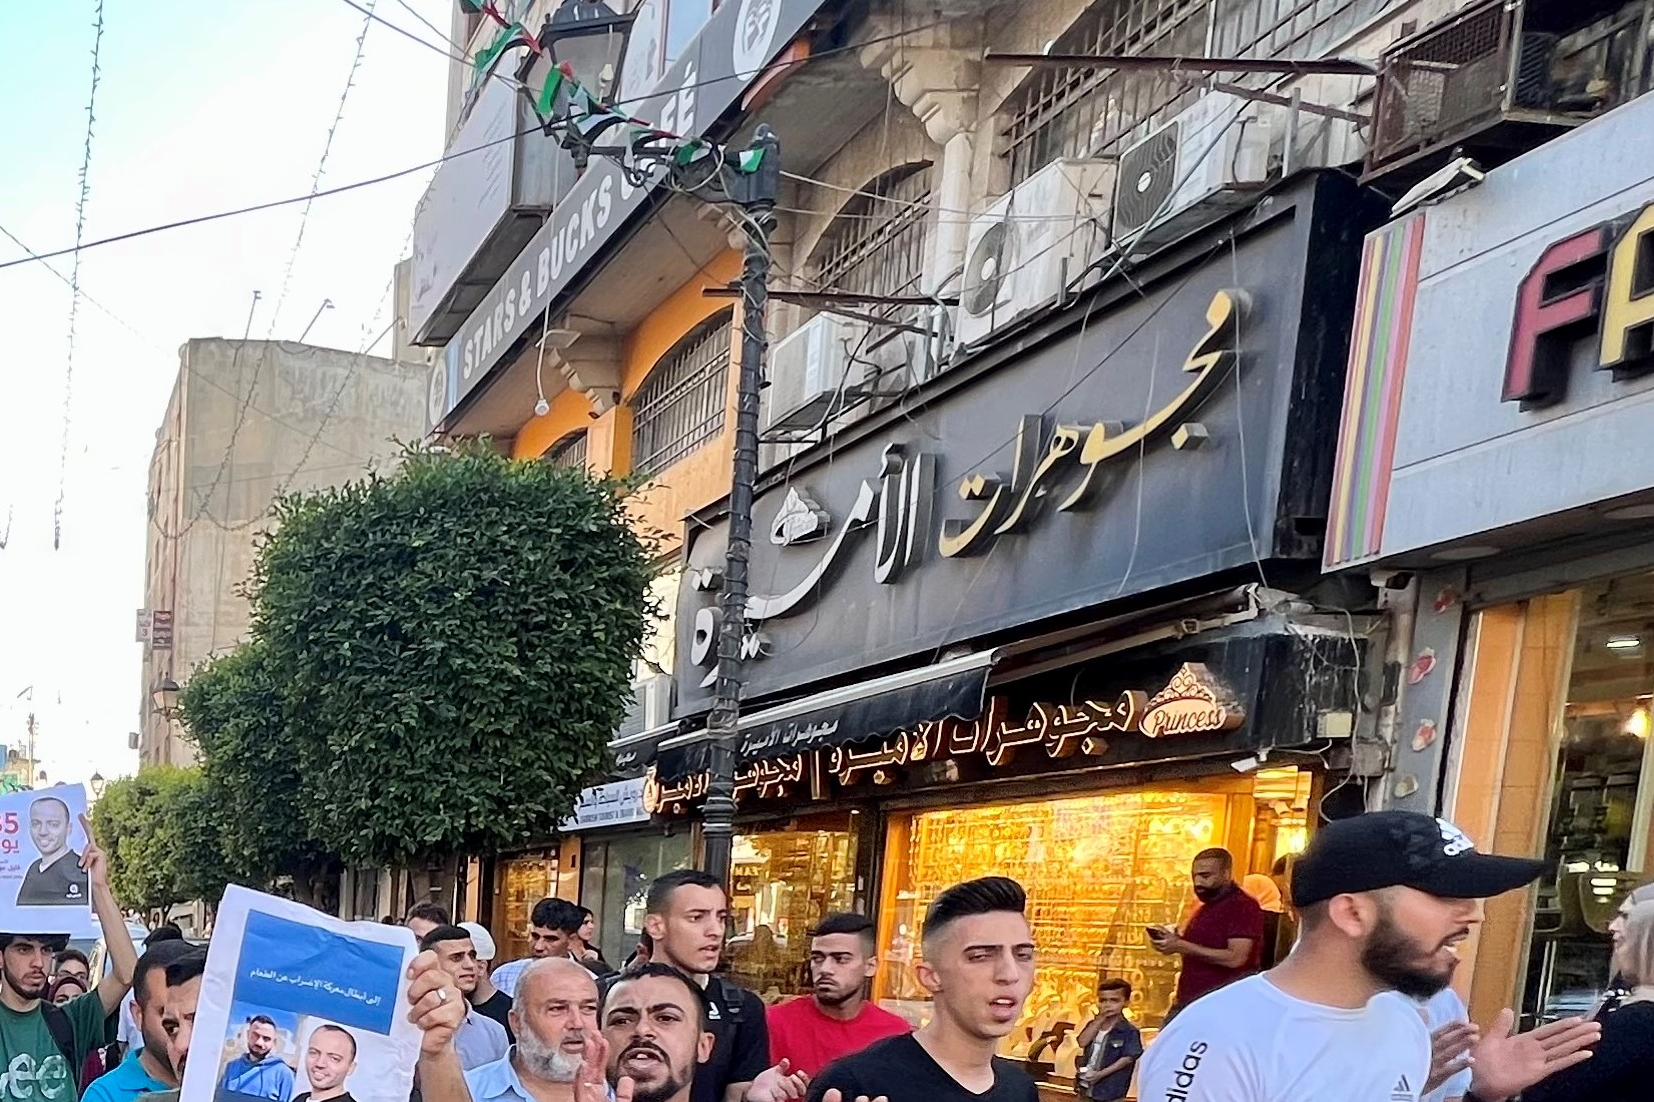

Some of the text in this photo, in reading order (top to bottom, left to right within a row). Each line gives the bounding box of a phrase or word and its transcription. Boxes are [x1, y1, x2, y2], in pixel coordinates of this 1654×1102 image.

[462, 287, 516, 380] STARS
[517, 270, 532, 316] &
[536, 173, 612, 299] BUCKS
[939, 288, 1236, 558] مجوهرات
[782, 718, 840, 748] مجوهرات
[949, 689, 1136, 767] مجوهرات
[1152, 704, 1225, 736] Princess
[250, 967, 276, 979] الطعام
